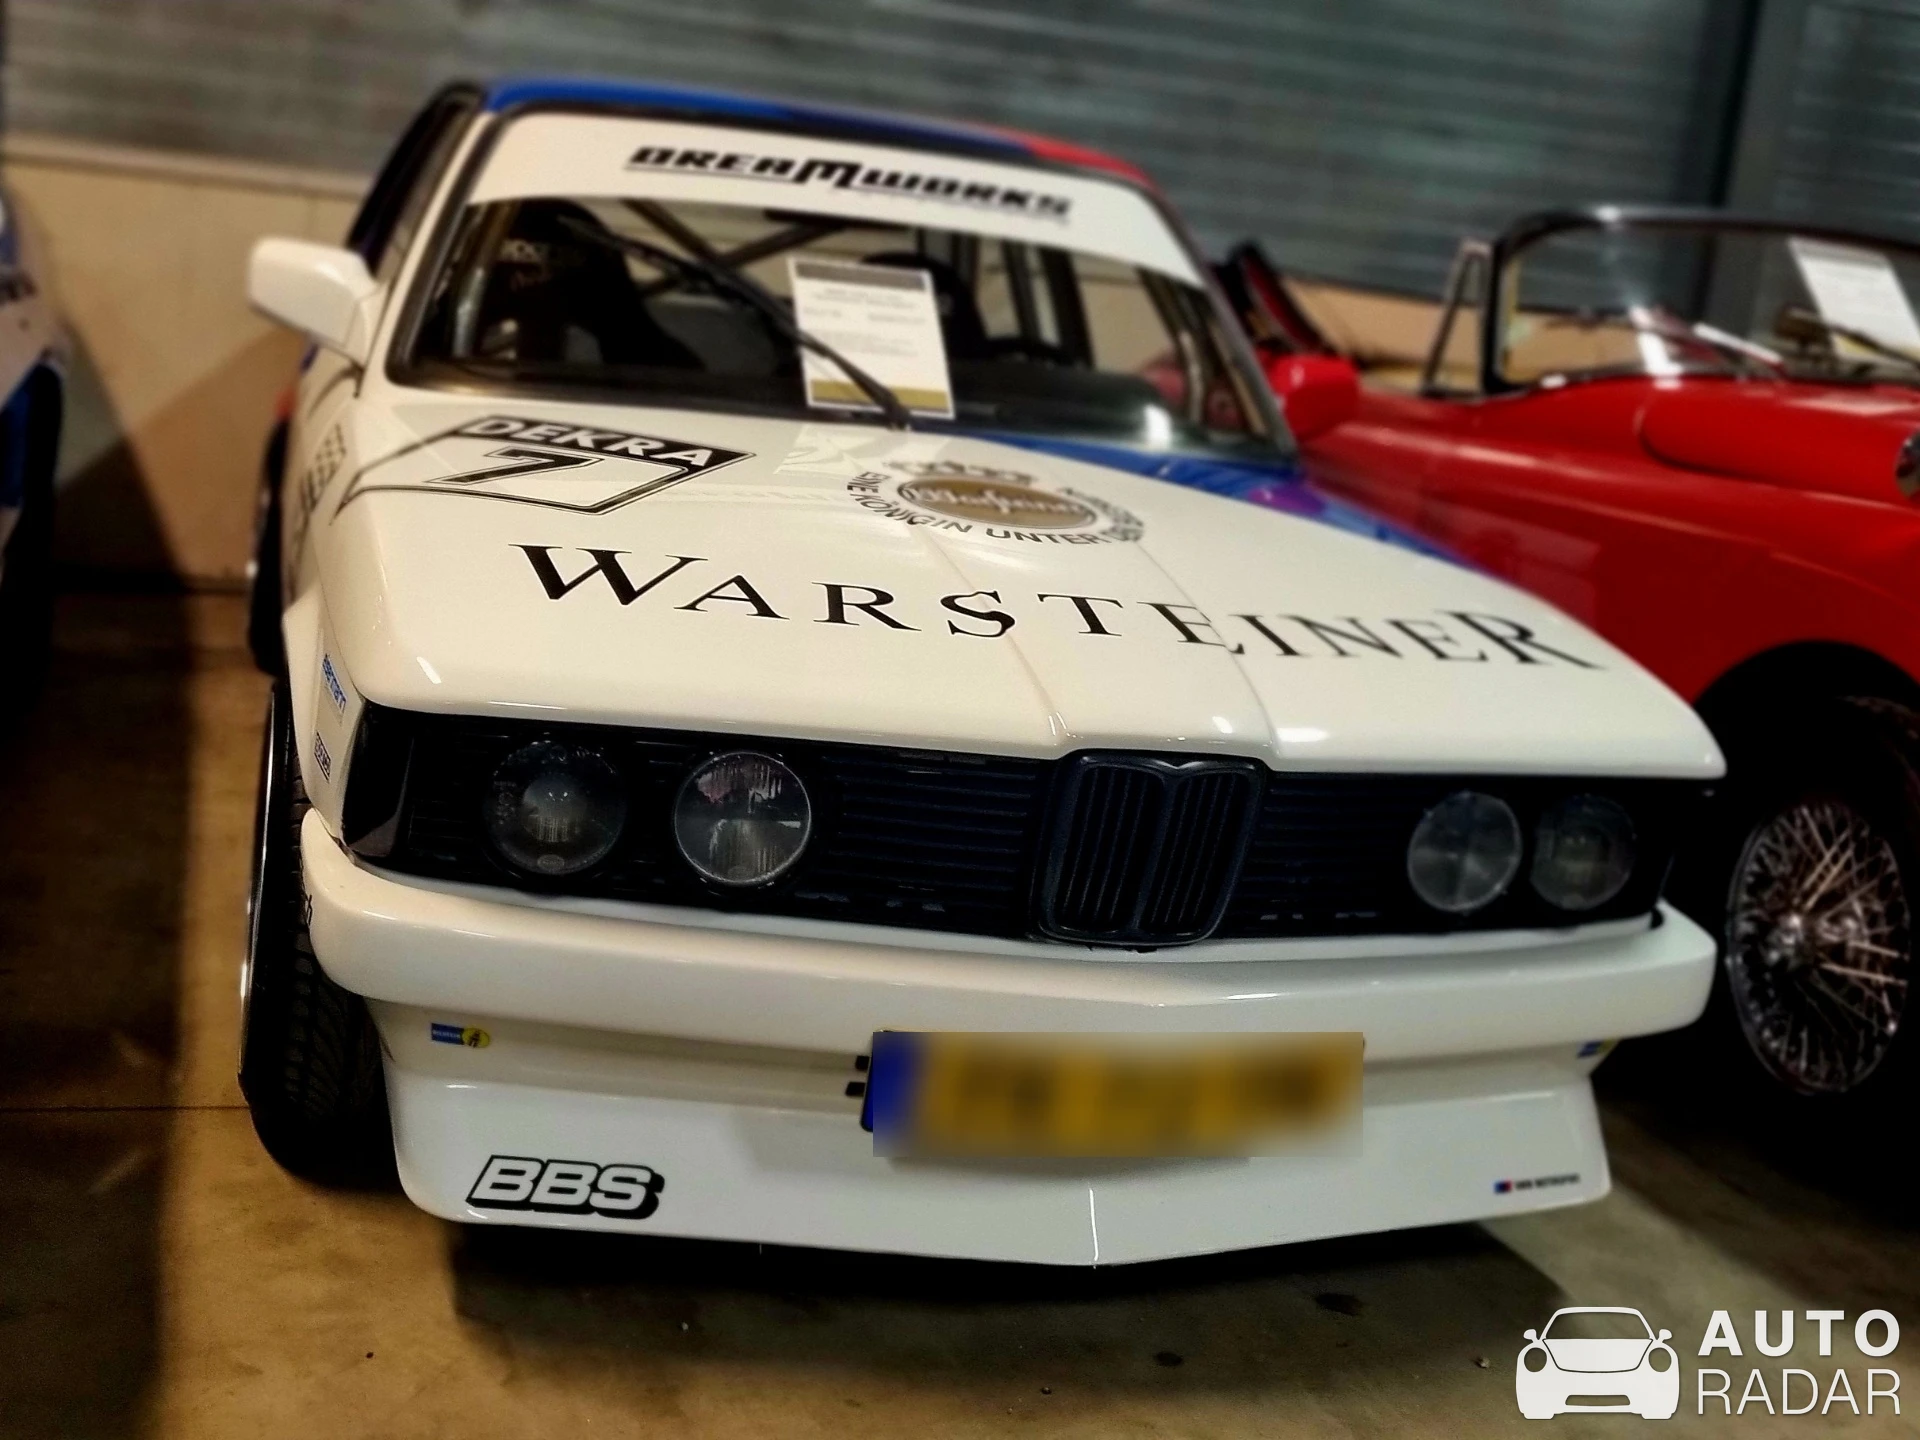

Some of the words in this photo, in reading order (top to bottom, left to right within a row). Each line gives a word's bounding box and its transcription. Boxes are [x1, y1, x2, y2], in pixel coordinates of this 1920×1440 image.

[423, 446, 606, 486] 7
[461, 417, 713, 467] DEKRA
[849, 493, 974, 533] KÖNIGIN
[986, 528, 1112, 545] UNTER
[508, 543, 1607, 670] WARSTEINER
[465, 1154, 666, 1220] BBS
